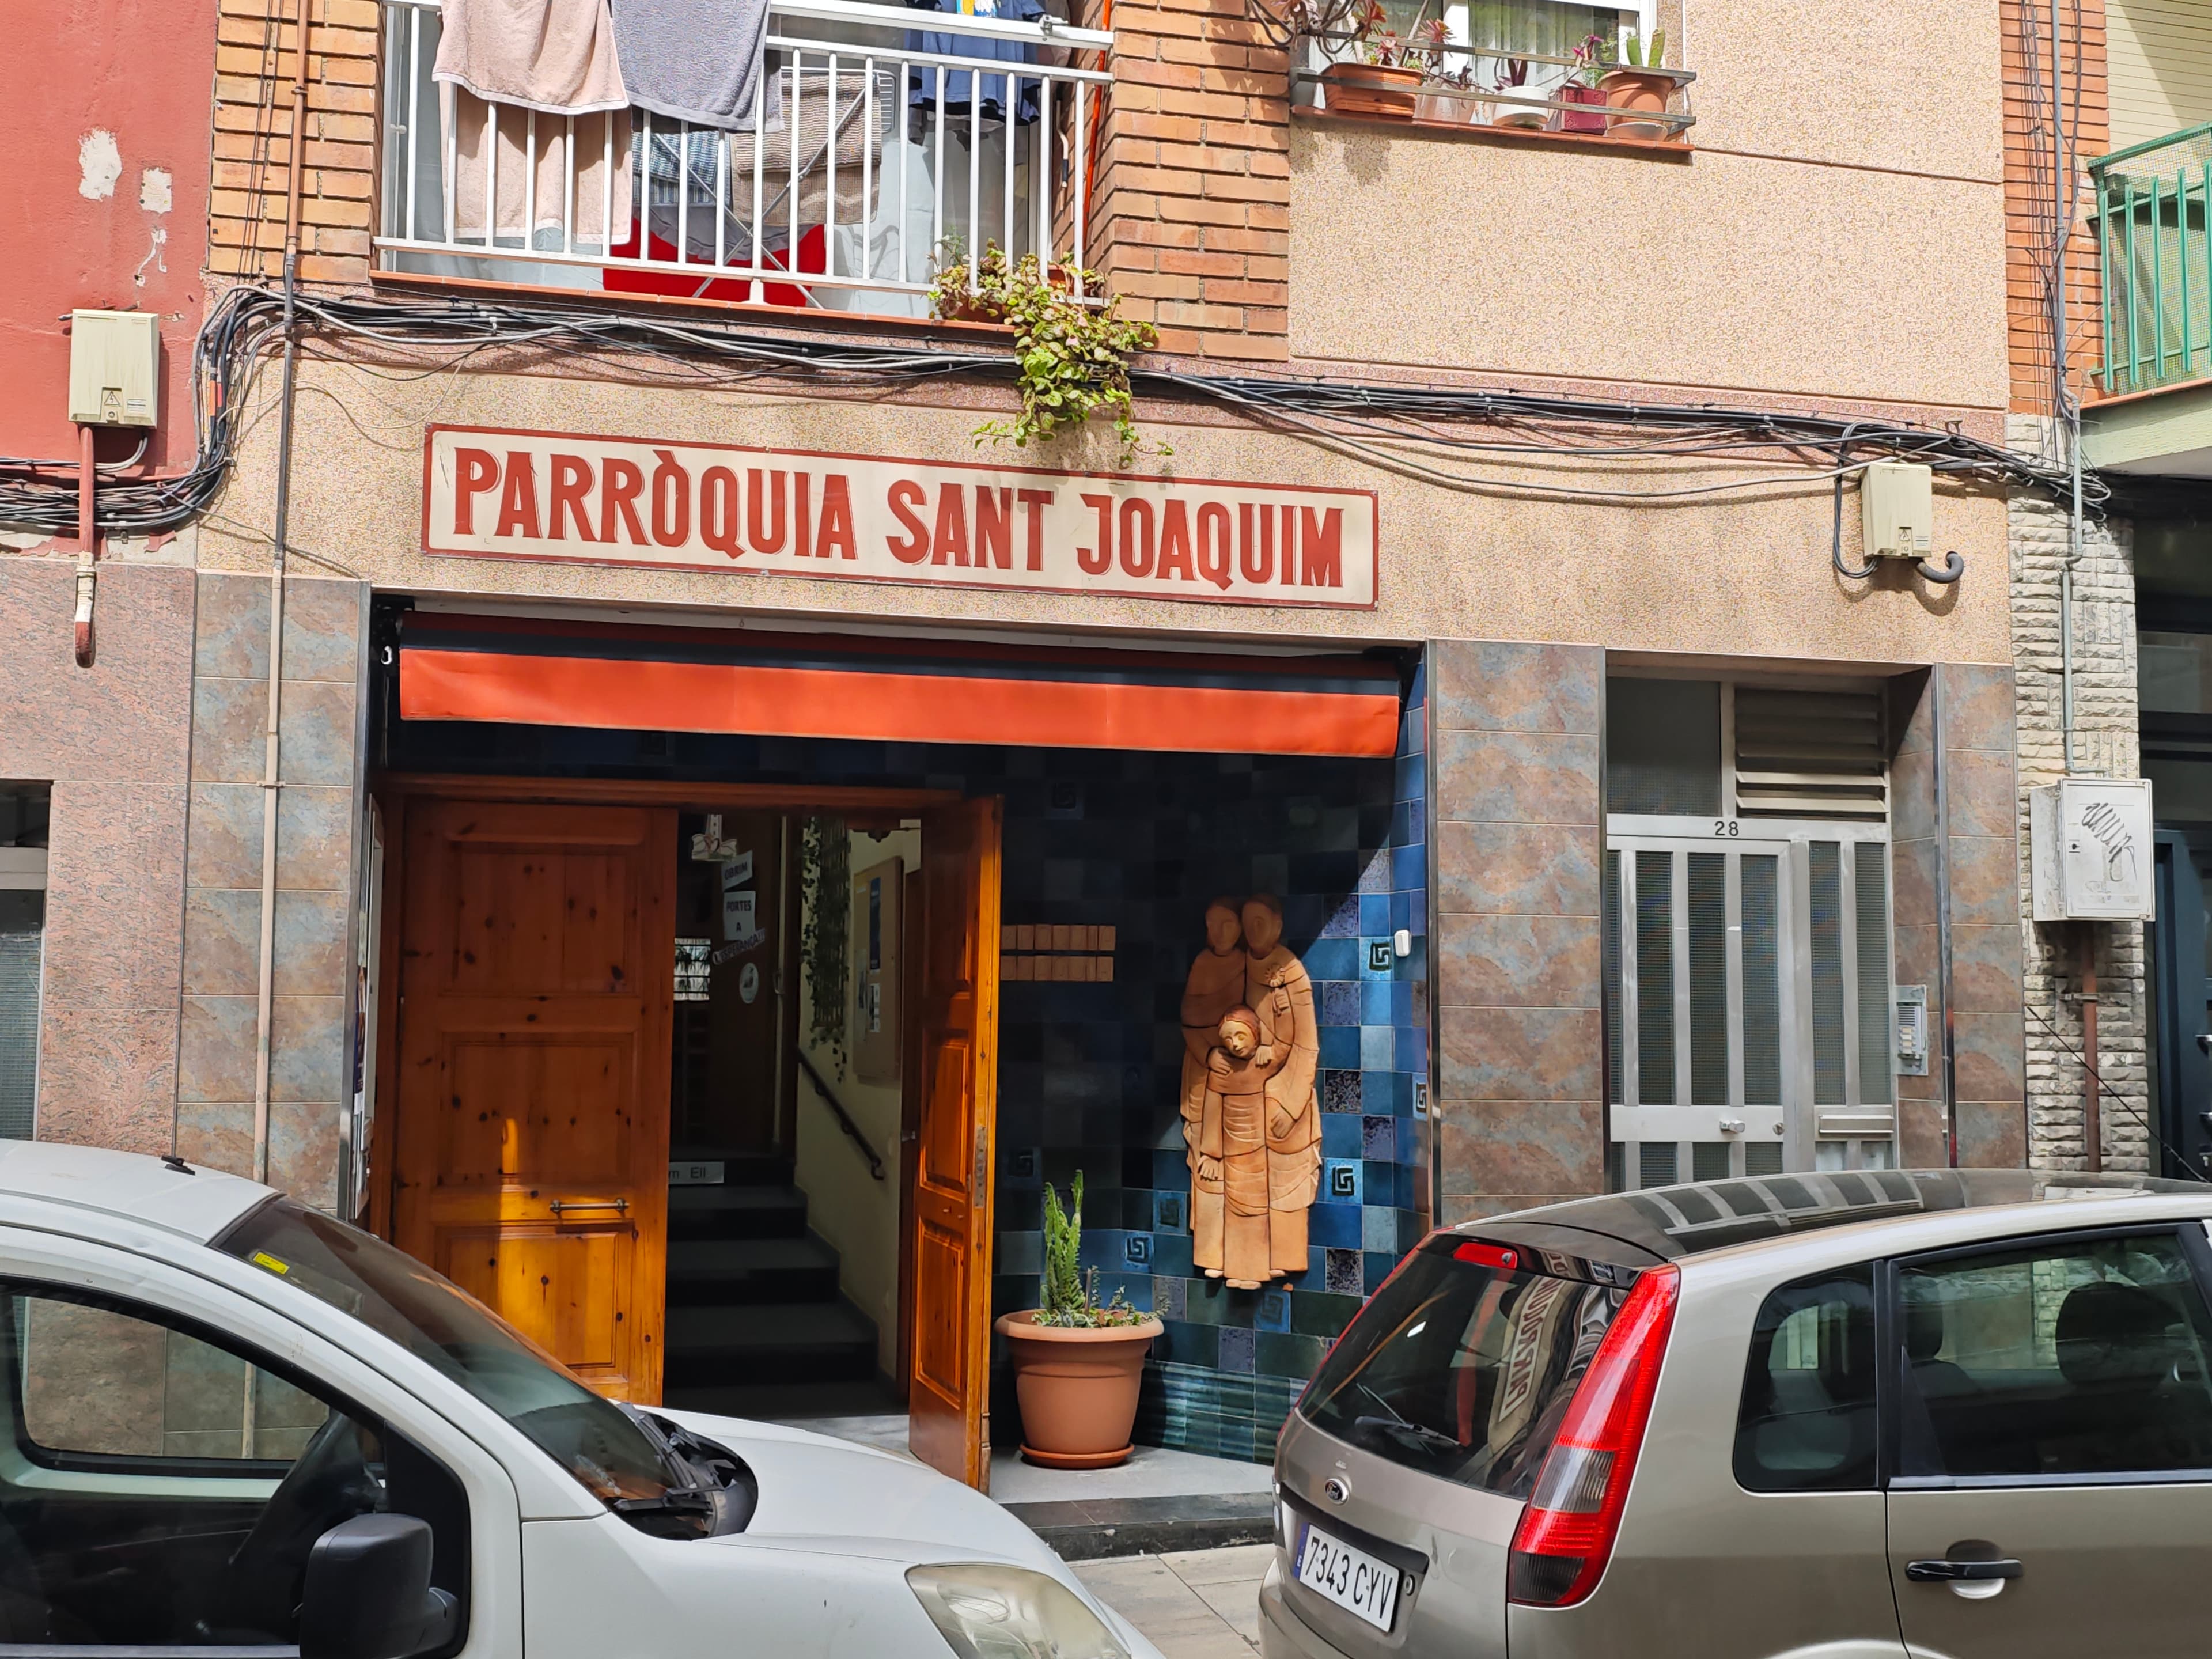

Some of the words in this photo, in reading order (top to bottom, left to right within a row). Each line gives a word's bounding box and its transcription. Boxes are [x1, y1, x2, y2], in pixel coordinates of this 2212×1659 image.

[453, 447, 859, 560] PARRÒQUIA
[885, 479, 1054, 573] SANT
[1077, 493, 1344, 592] JOAQUIM
[1714, 820, 1739, 837] 28
[724, 861, 748, 881] OBRIM
[726, 900, 752, 912] PORTES
[736, 921, 742, 933] A
[1305, 1536, 1350, 1596] 7343
[1353, 1562, 1393, 1619] CYV
